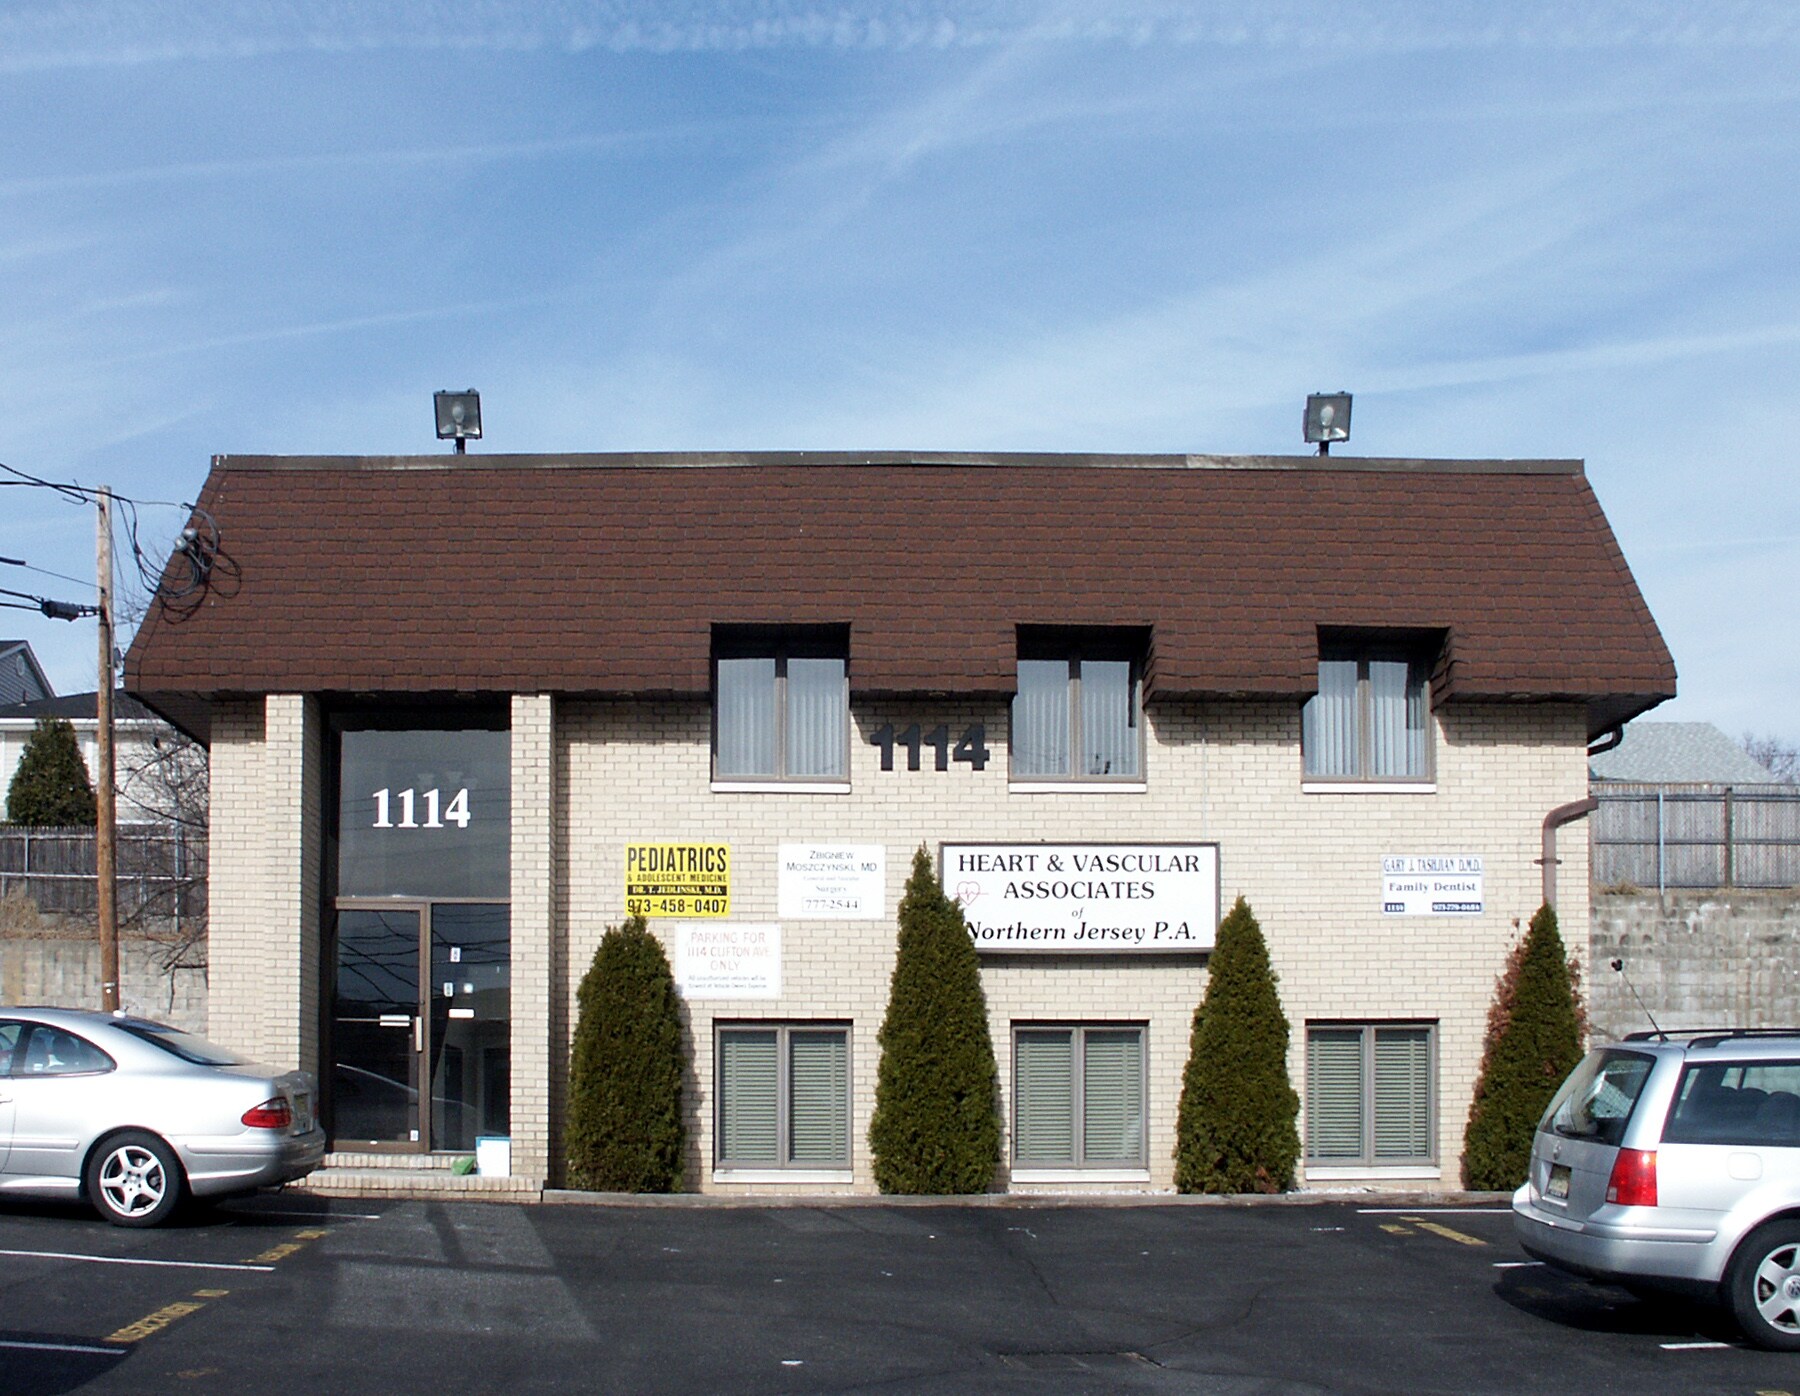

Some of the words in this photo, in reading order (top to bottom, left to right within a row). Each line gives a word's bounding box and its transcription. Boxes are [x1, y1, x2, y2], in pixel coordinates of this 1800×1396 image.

[870, 723, 990, 771] 1114
[372, 788, 471, 828] 1114
[627, 847, 727, 872] PEDIATRICS
[809, 850, 855, 860] ZBIGNIEW
[860, 862, 878, 872] MD
[958, 854, 1039, 872] HEART
[1047, 854, 1065, 872] &
[1072, 854, 1200, 872] VASCULAR
[637, 873, 686, 882] ADOLESCENT
[690, 873, 727, 882] MEDICINE
[1003, 881, 1155, 899] ASSOCIATES
[1389, 882, 1429, 893] Family
[1433, 882, 1477, 891] Dentist
[627, 899, 728, 913] 973-458-0407
[805, 899, 858, 910] 777-2544
[1071, 907, 1085, 919] of
[690, 931, 738, 944] PARKING
[743, 931, 766, 944] FOR
[965, 921, 1066, 940] Northern
[1073, 921, 1146, 944] Jersey
[1153, 921, 1197, 940] P.A.
[687, 946, 707, 958] 1114
[710, 946, 750, 958] CLIFTON
[710, 960, 741, 971] ONLY
